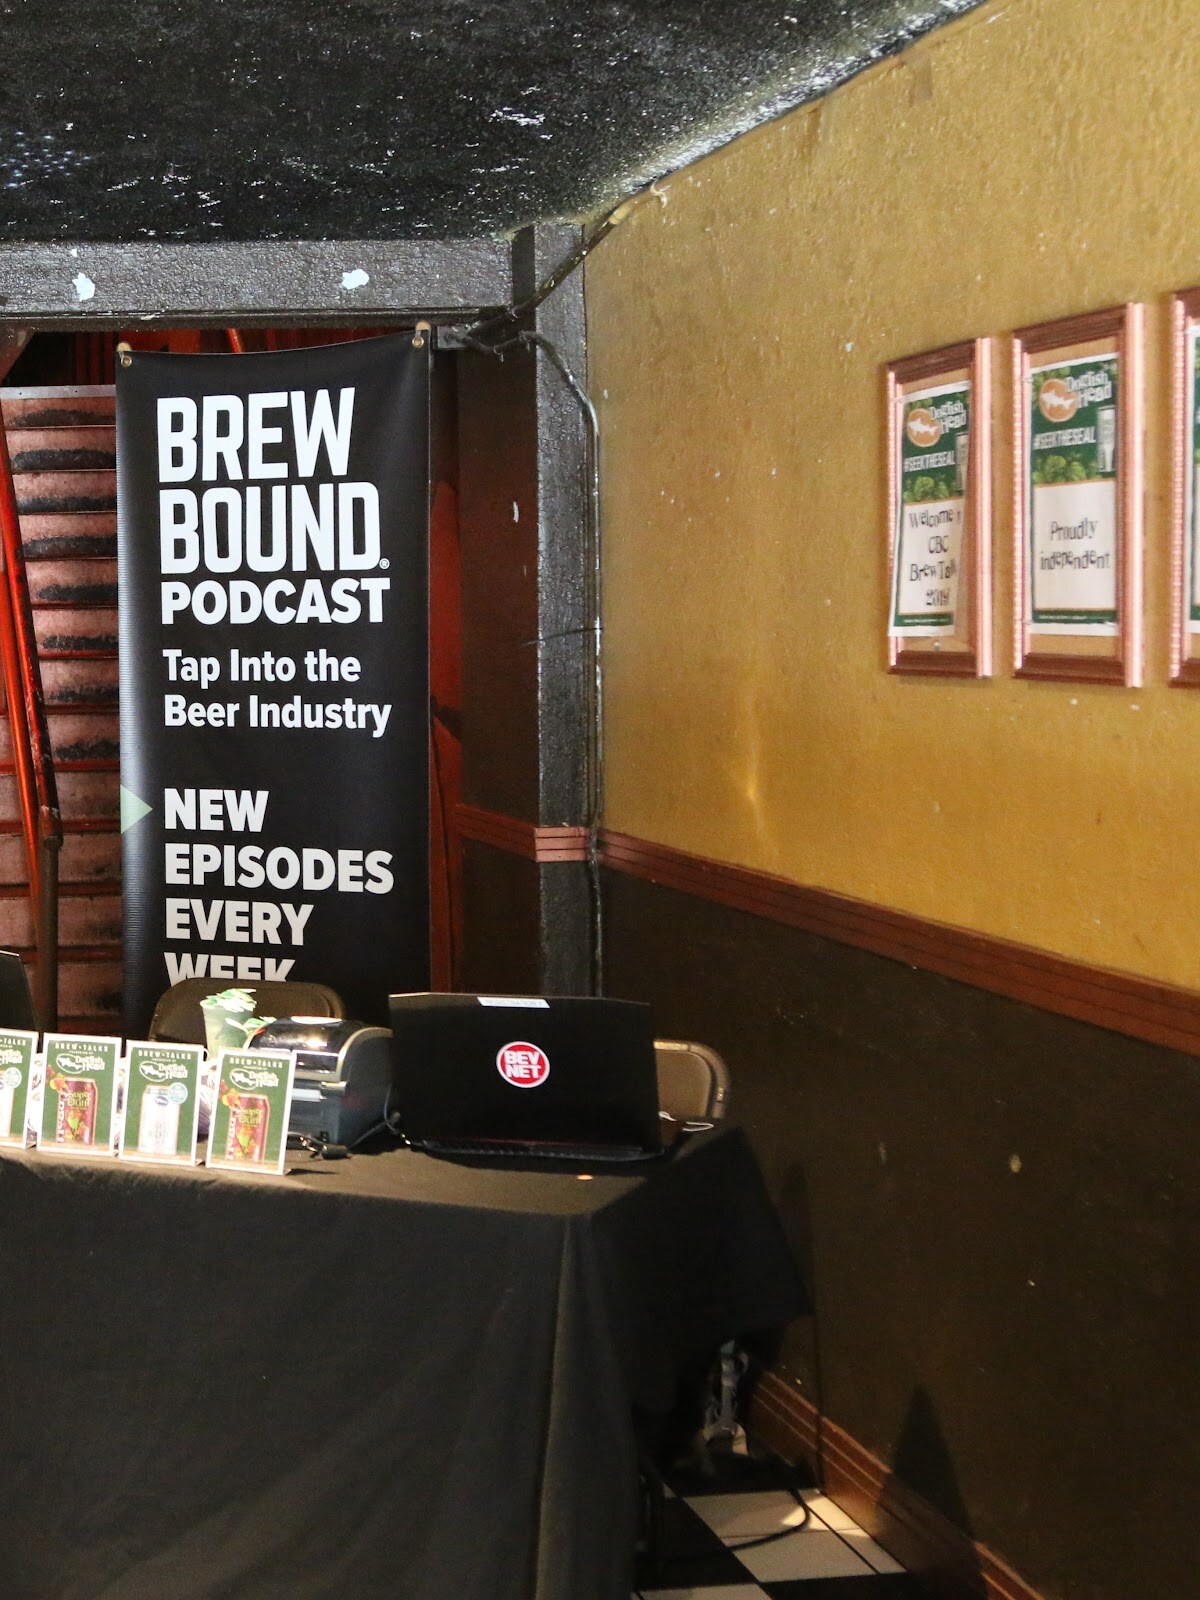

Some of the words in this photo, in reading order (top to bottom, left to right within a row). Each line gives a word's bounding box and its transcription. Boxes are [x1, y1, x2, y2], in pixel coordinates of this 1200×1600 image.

[1077, 381, 1112, 408] Head
[157, 387, 355, 482] BREW
[909, 509, 954, 528] Welcome
[1050, 517, 1098, 541] Proudly
[928, 535, 950, 554] CBC
[1040, 550, 1111, 570] independent
[161, 578, 390, 624] PODCAST
[163, 649, 220, 689] Tap
[231, 649, 296, 681] Into
[304, 649, 361, 682] the
[165, 695, 239, 727] Beer
[250, 695, 392, 737] Industry
[165, 788, 269, 832] NEW
[165, 843, 393, 894] EPISODES
[166, 898, 314, 945] EVERY
[3, 1037, 26, 1046] TALKS
[55, 1042, 78, 1050] BREW
[83, 1044, 109, 1052] TALKS
[166, 1051, 192, 1060] TALKS
[229, 1057, 252, 1065] BREW
[258, 1059, 283, 1068] TALKS
[503, 1050, 540, 1064] BEV
[504, 1064, 541, 1078] NET
